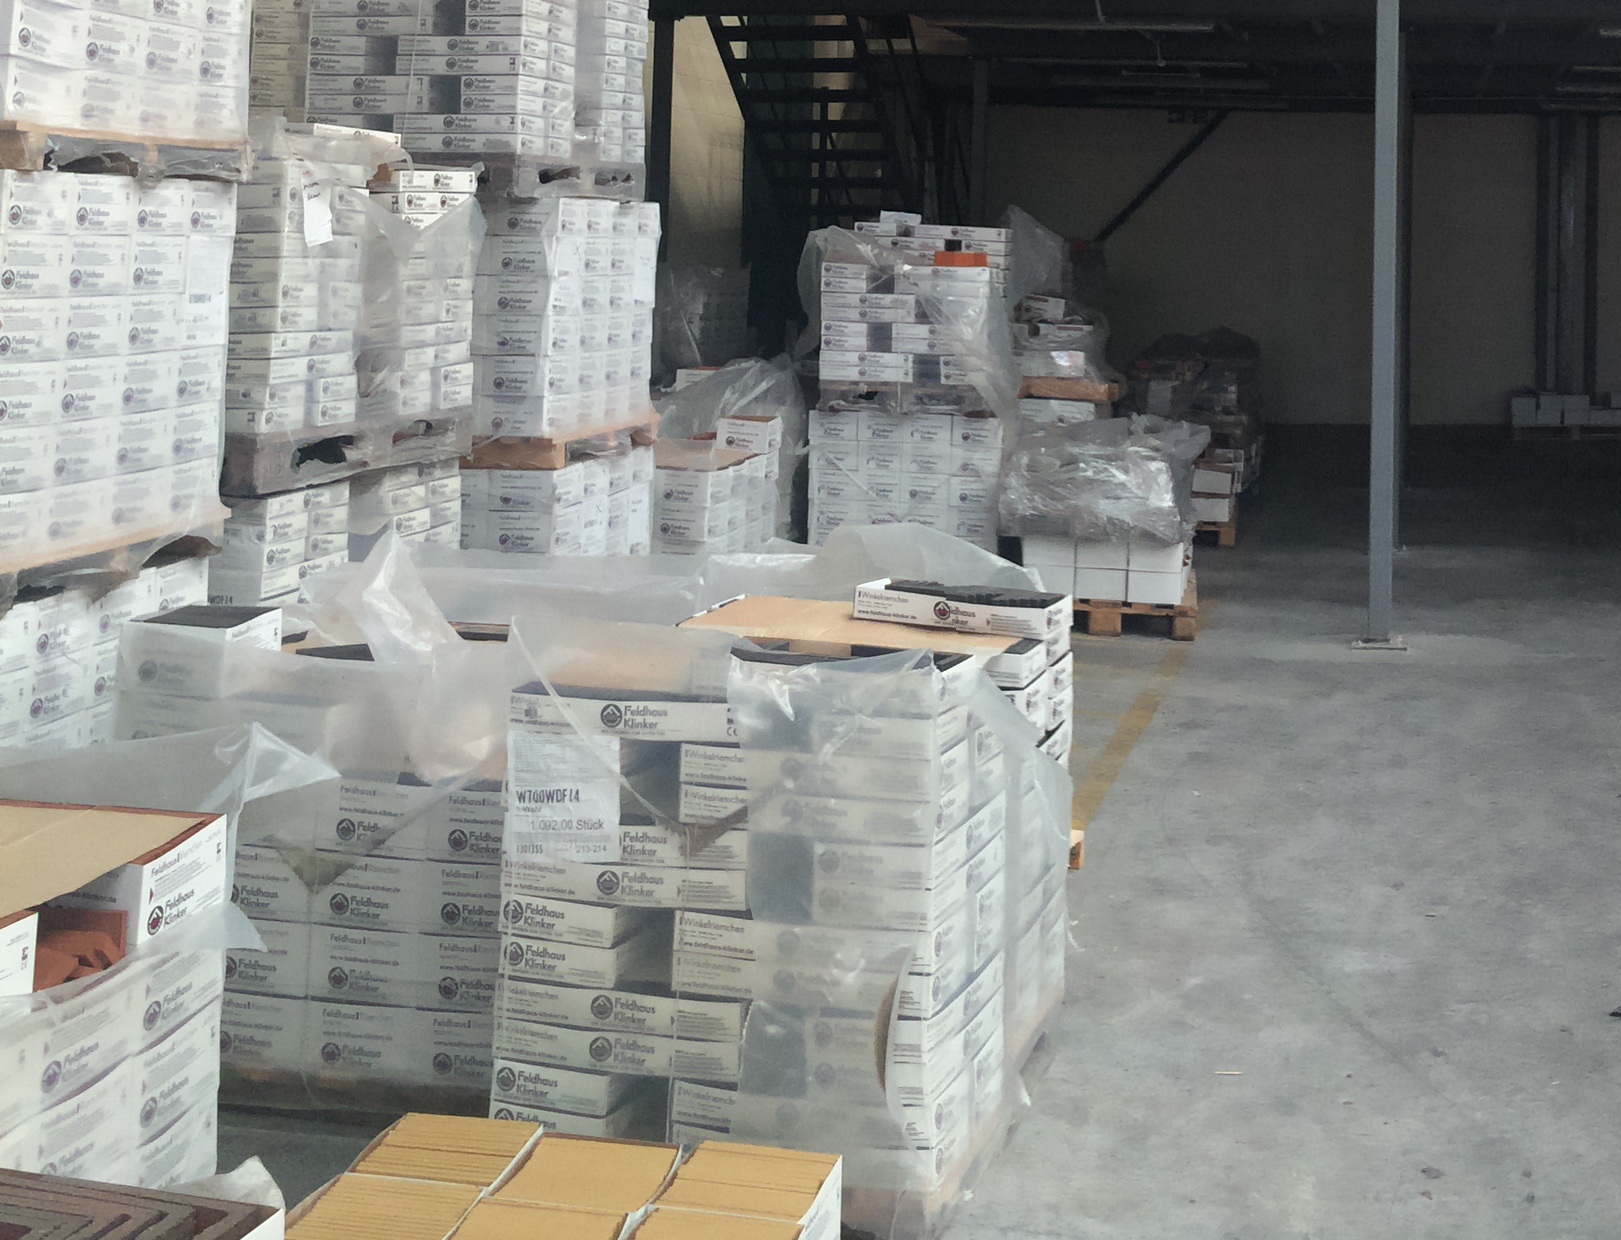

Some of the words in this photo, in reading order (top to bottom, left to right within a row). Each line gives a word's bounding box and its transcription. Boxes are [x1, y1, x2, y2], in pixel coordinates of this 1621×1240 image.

[950, 606, 976, 618] ldhaus
[624, 705, 668, 717] Feldhaus
[623, 717, 658, 729] Klinker
[689, 751, 744, 763] Winkelriemche
[623, 831, 667, 844] Feldhaus
[623, 843, 657, 856] Klinker
[621, 872, 664, 885] Feldhaus
[241, 886, 278, 898] Feldhaus
[621, 884, 655, 896] Klinker
[164, 889, 195, 910] Feldhaus
[240, 897, 270, 909] Klinker
[351, 896, 389, 909] Feldhaus
[164, 906, 188, 928] Klinker
[351, 908, 380, 920] Klinker
[462, 905, 500, 917] Feldhau
[525, 903, 565, 919] Feldhaus
[462, 916, 493, 928] Klinker
[524, 915, 556, 930] Klinker
[525, 945, 565, 961] Feldhaus
[239, 960, 277, 972] Feldhaus
[524, 958, 557, 972] Klinker
[460, 979, 495, 991] Feldhau
[614, 998, 655, 1014] Feldhaus
[613, 1011, 646, 1025] Klinker
[614, 1039, 655, 1054] Feldhaus
[613, 1051, 646, 1066] Klinker
[518, 1071, 558, 1087] Feldhaus
[517, 1084, 549, 1098] Klinker
